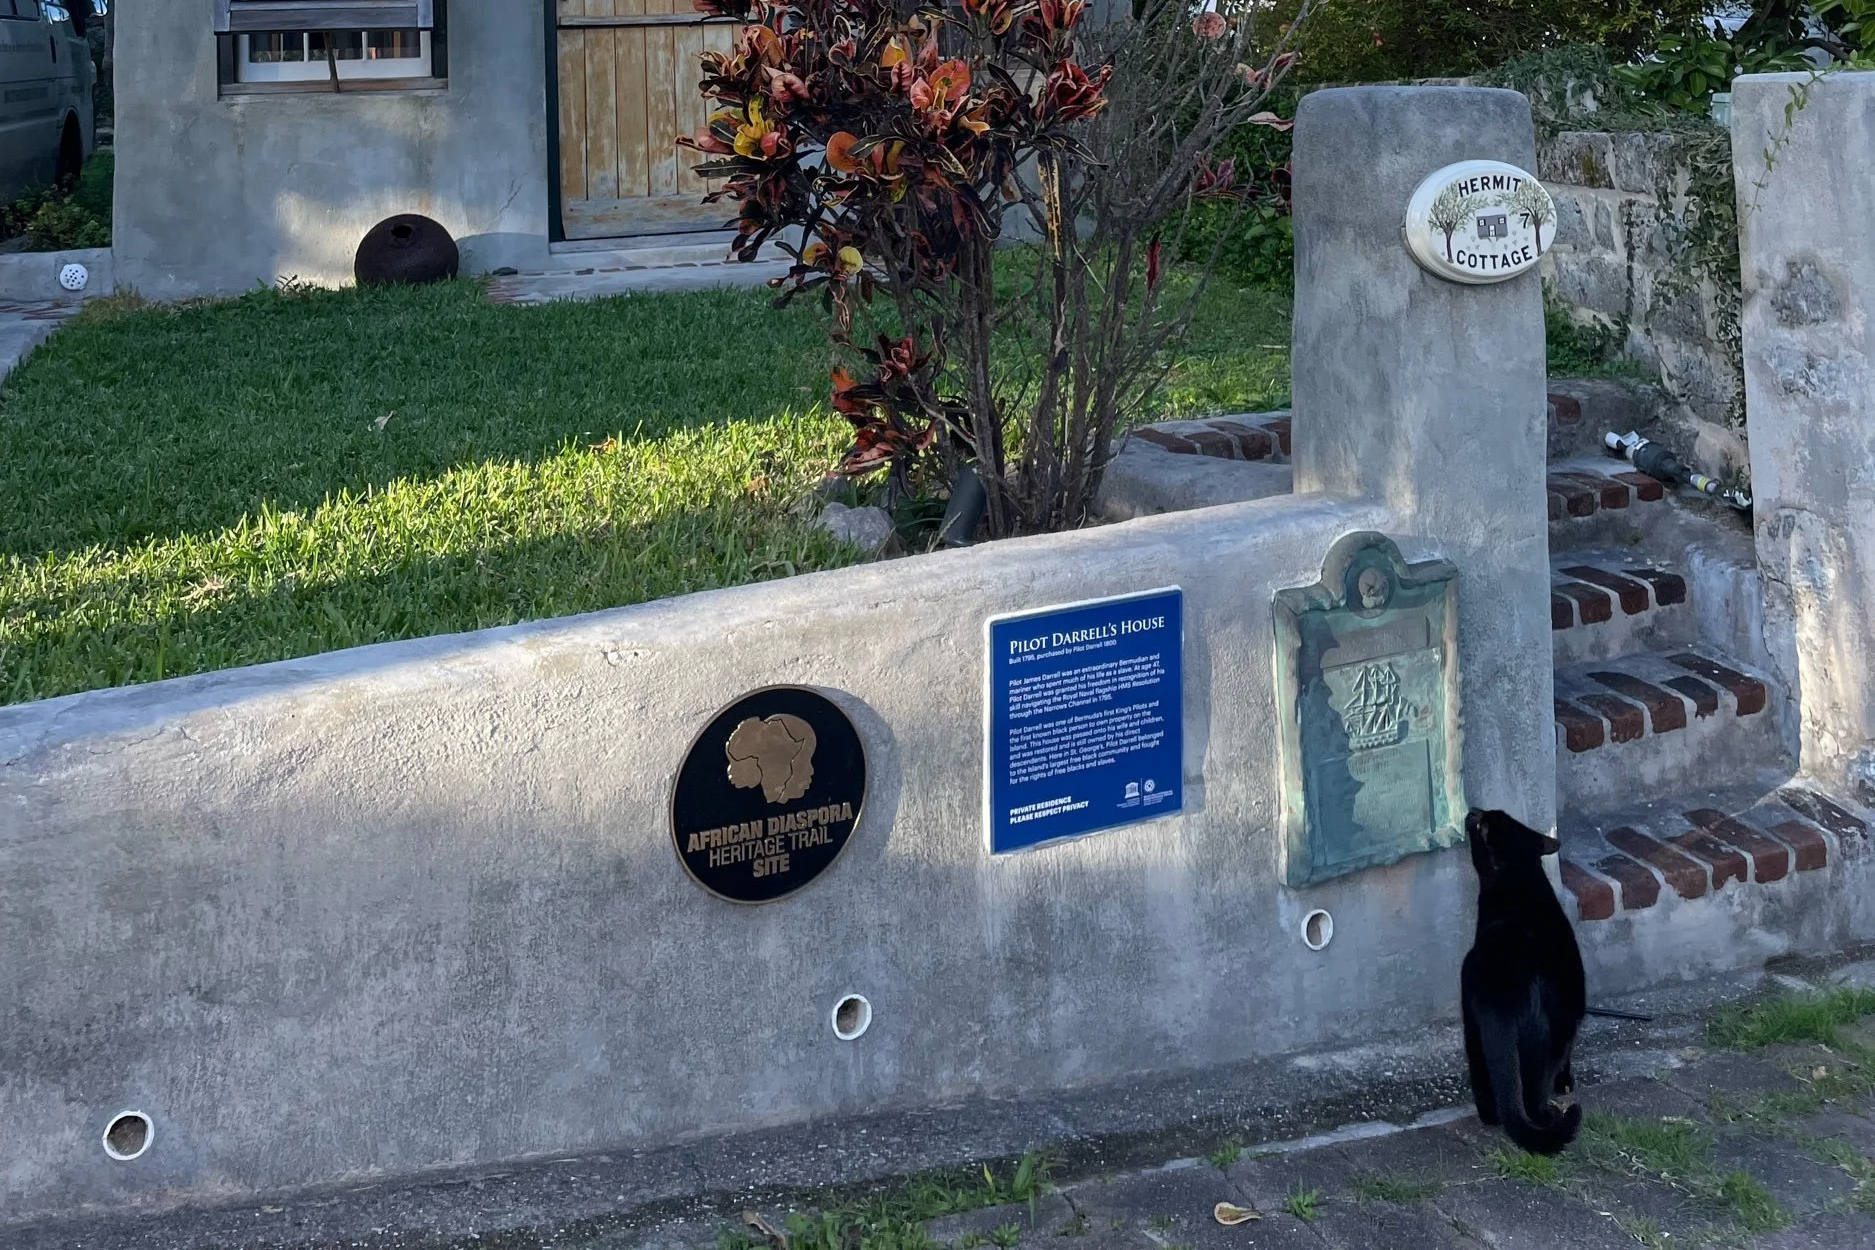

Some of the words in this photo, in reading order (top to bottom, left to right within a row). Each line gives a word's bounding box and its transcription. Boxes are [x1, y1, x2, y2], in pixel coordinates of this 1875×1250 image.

[1458, 175, 1521, 197] HERMIT
[1520, 213, 1530, 229] 7
[1456, 245, 1532, 269] COTTAGE
[1010, 636, 1048, 654] PILOT
[1052, 623, 1117, 646] DARRELL'S
[1121, 616, 1164, 634] HOUSE
[1036, 648, 1065, 660] purchased
[1085, 641, 1103, 650] Darrell
[1009, 679, 1022, 687] Pilot
[1023, 676, 1041, 684] James
[1042, 671, 1060, 680] Darrell
[1081, 662, 1118, 673] extraordinary
[1119, 656, 1148, 666] Bermudian
[1009, 686, 1031, 694] mariner
[1046, 680, 1062, 688] spent
[1063, 676, 1079, 684] much
[1009, 695, 1022, 703] Pilot
[1023, 691, 1042, 700] Darrell
[1055, 684, 1077, 695] granted
[1087, 679, 1111, 688] freedom
[1118, 671, 1149, 681] recognition
[1009, 703, 1020, 711] skill
[1021, 698, 1051, 708] navigating
[1062, 692, 1078, 701] Royal
[1079, 688, 1094, 697] Naval
[1095, 685, 1117, 694] flagship
[1118, 682, 1131, 690] HMS
[1132, 677, 1160, 687] Resolution
[1009, 709, 1032, 719] through
[1044, 703, 1067, 712] Narrows
[1068, 697, 1091, 708] Channel
[1023, 723, 1042, 733] Darrell
[1148, 700, 1159, 708] and
[1032, 731, 1051, 739] known
[1052, 726, 1067, 735] black
[1068, 723, 1088, 733] person
[1109, 714, 1133, 724] property
[1042, 737, 1060, 745] house
[1072, 729, 1092, 740] passed
[1116, 722, 1128, 730] wife
[1129, 719, 1140, 727] and
[1009, 752, 1021, 760] and
[1034, 744, 1058, 755] restored
[1059, 741, 1070, 750] and
[1076, 738, 1086, 746] still
[1087, 734, 1106, 744] owned
[1124, 728, 1140, 736] direct
[1049, 752, 1062, 760] Here
[1106, 740, 1118, 748] Pilot
[1119, 736, 1137, 745] Darrell
[1138, 730, 1164, 741] belonged
[1049, 759, 1069, 768] largest
[1082, 752, 1097, 761] black
[1098, 746, 1129, 758] community
[1130, 743, 1140, 751] and
[1141, 740, 1159, 748] fought
[1030, 772, 1046, 780] rights
[1067, 763, 1085, 772] blacks
[1086, 760, 1096, 768] and
[1010, 804, 1036, 816] PRIVATE
[1037, 796, 1071, 810] RESIDENCE
[1010, 813, 1033, 824] PLEASE
[1034, 806, 1062, 819] RESPECT
[1062, 800, 1089, 812] PRIVACY
[687, 820, 763, 852] AFRICAN
[768, 802, 853, 835] DIASPORA
[709, 835, 785, 868] HERITAGE
[788, 827, 833, 850] TRAIL
[753, 854, 790, 878] SITE
